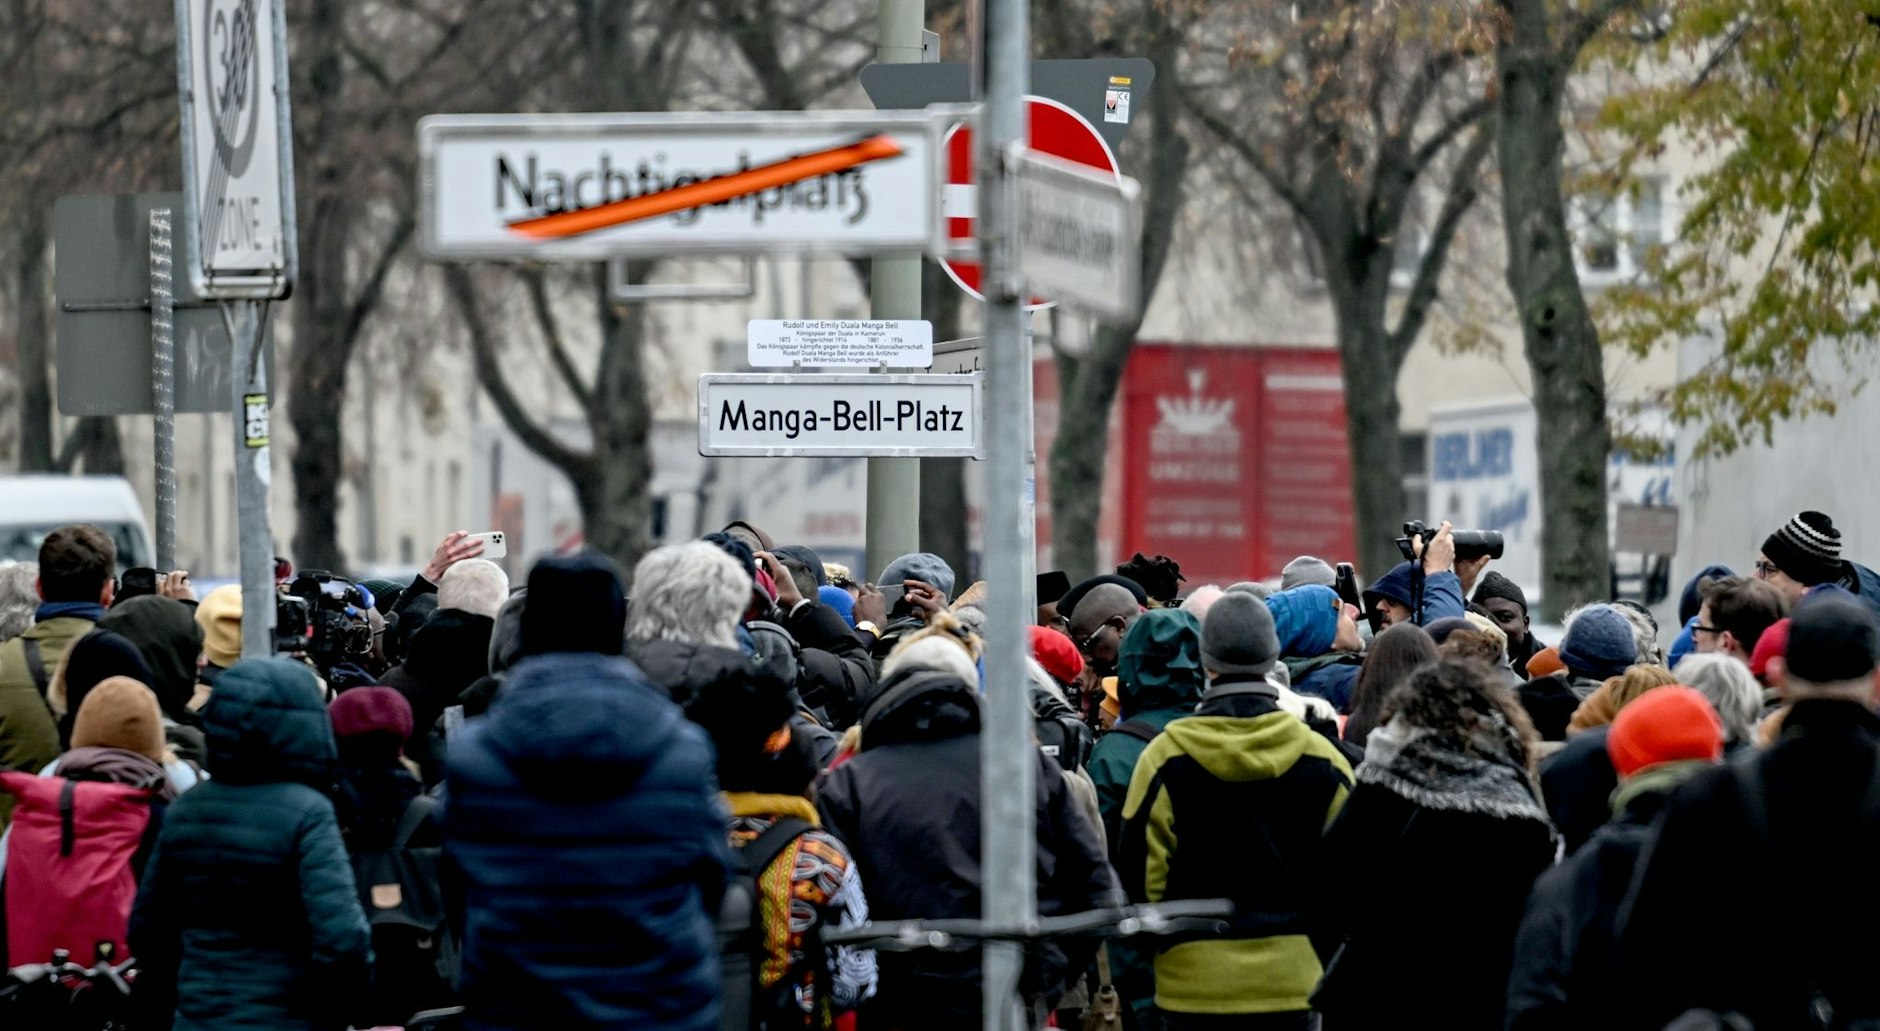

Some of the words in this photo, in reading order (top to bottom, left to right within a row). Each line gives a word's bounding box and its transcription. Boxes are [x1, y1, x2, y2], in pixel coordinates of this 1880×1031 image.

[218, 197, 262, 251] ZONE
[820, 322, 839, 330] Emily
[862, 322, 884, 330] Manga
[718, 400, 964, 438] Manga-Bell-Platz
